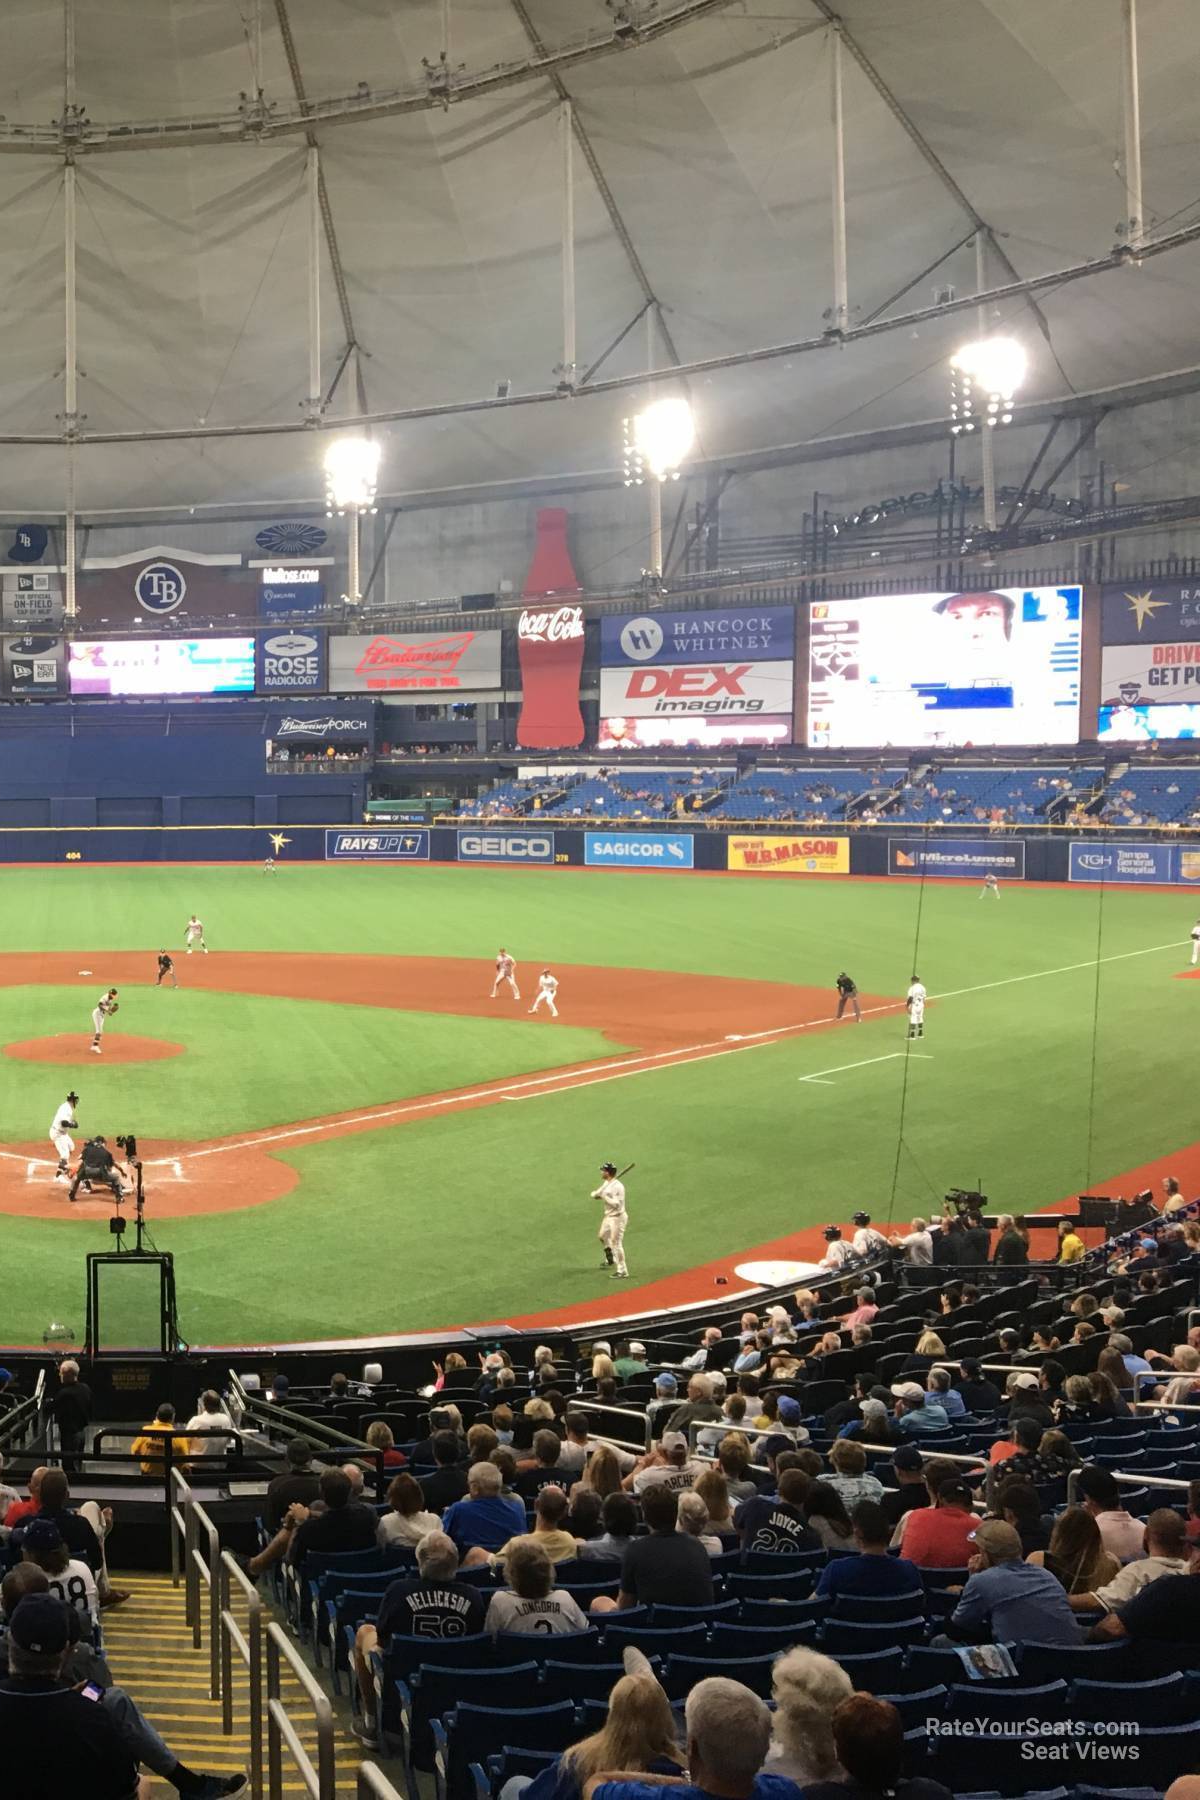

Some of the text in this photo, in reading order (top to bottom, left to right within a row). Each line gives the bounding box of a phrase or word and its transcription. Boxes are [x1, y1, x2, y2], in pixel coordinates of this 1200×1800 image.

[145, 573, 178, 603] TB
[14, 600, 52, 609] ON-FIELD
[673, 618, 773, 635] HANCOCK
[673, 635, 772, 652] WHITNEY
[264, 656, 319, 675] ROSE
[264, 675, 318, 686] RADIOLOGY
[625, 665, 753, 699] DEX
[1148, 668, 1181, 686] GET
[655, 697, 764, 712] imaging
[280, 719, 367, 730] Budweiser PORCH
[461, 838, 550, 856] GEICO
[593, 842, 663, 856] SAGICOR
[1118, 850, 1149, 860] Tampa
[920, 853, 1015, 863] MicroLumen
[1084, 855, 1112, 865] TGH
[1118, 866, 1156, 875] Hospital
[769, 1512, 804, 1537] JOYCE
[752, 1528, 800, 1552] 20
[406, 1590, 472, 1615] HELLICKSON
[515, 1601, 561, 1617] LONGORIA
